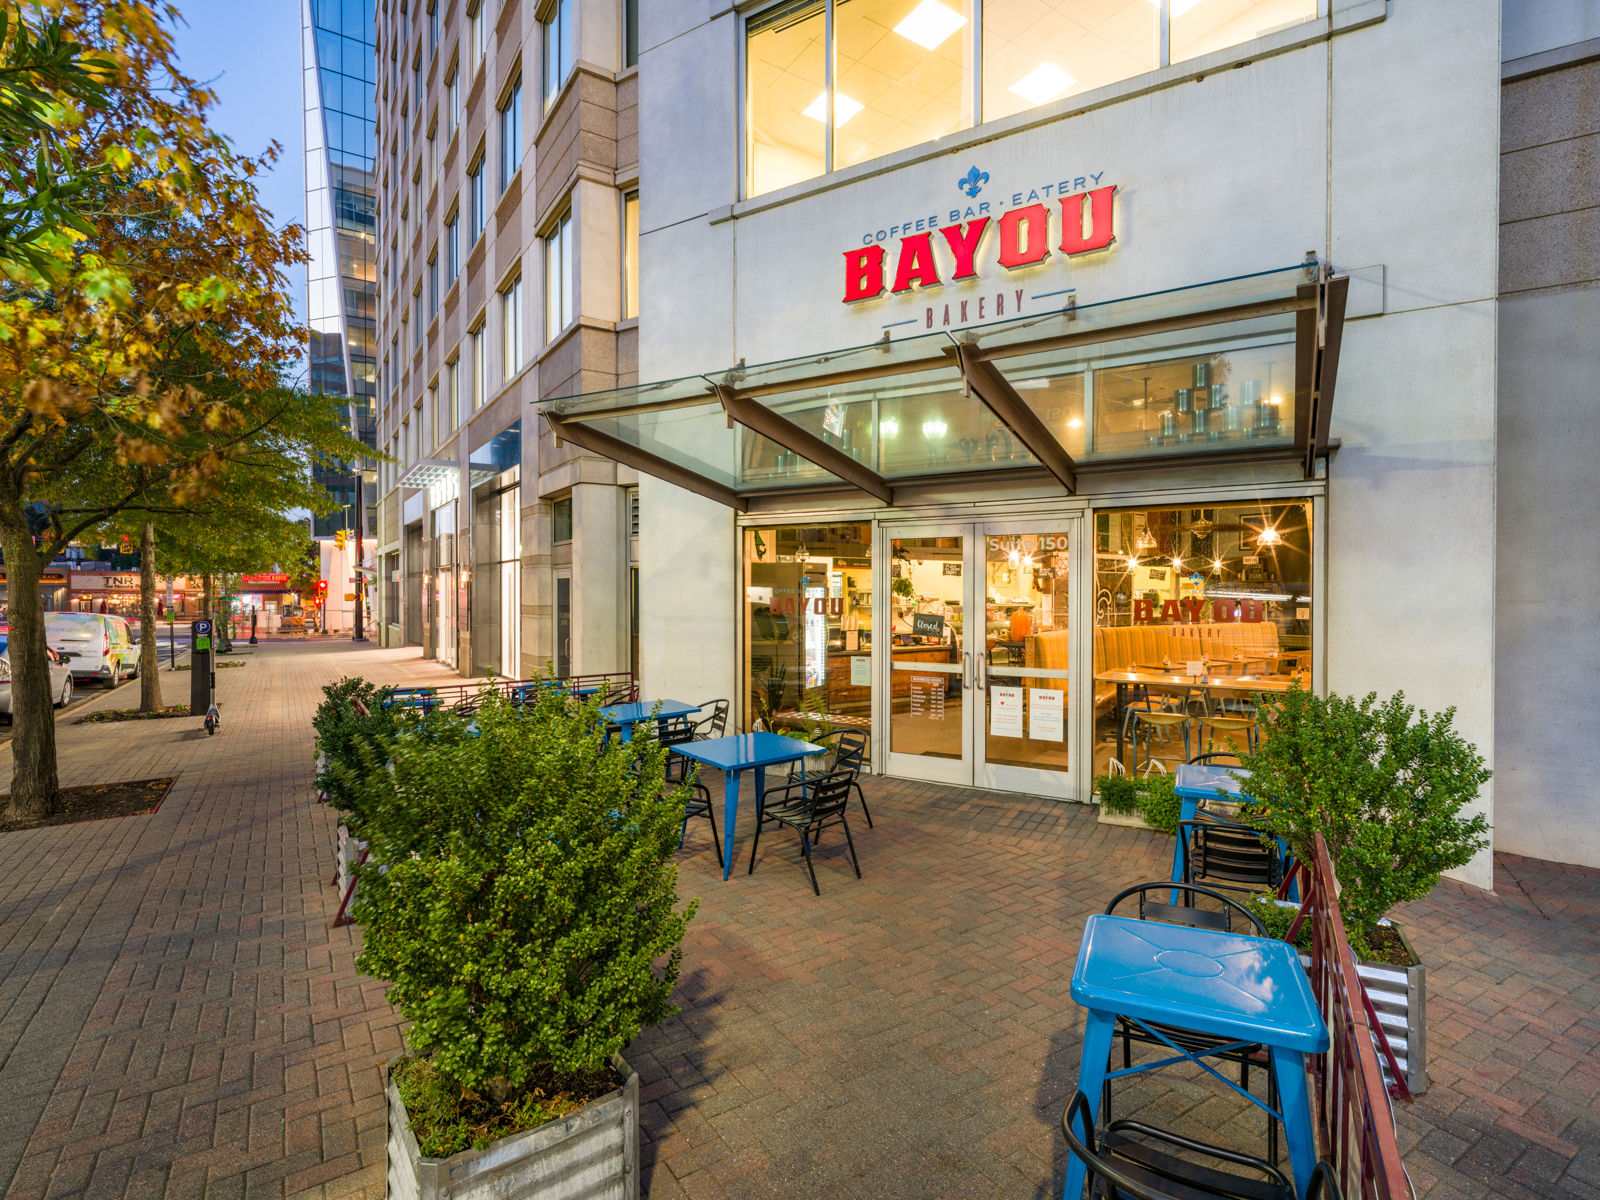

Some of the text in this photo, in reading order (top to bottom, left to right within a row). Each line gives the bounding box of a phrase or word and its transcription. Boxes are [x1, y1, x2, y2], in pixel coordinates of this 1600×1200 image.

[862, 171, 1104, 246] COFFEE BAR EATERY
[842, 184, 1118, 306] BAYOU
[926, 289, 1024, 329] BAKERY
[989, 536, 1068, 551] Suite 150
[770, 597, 844, 615] BAYOU
[1133, 599, 1263, 622] BAYOU
[917, 618, 939, 630] Closed
[1172, 627, 1221, 639] BAKERY
